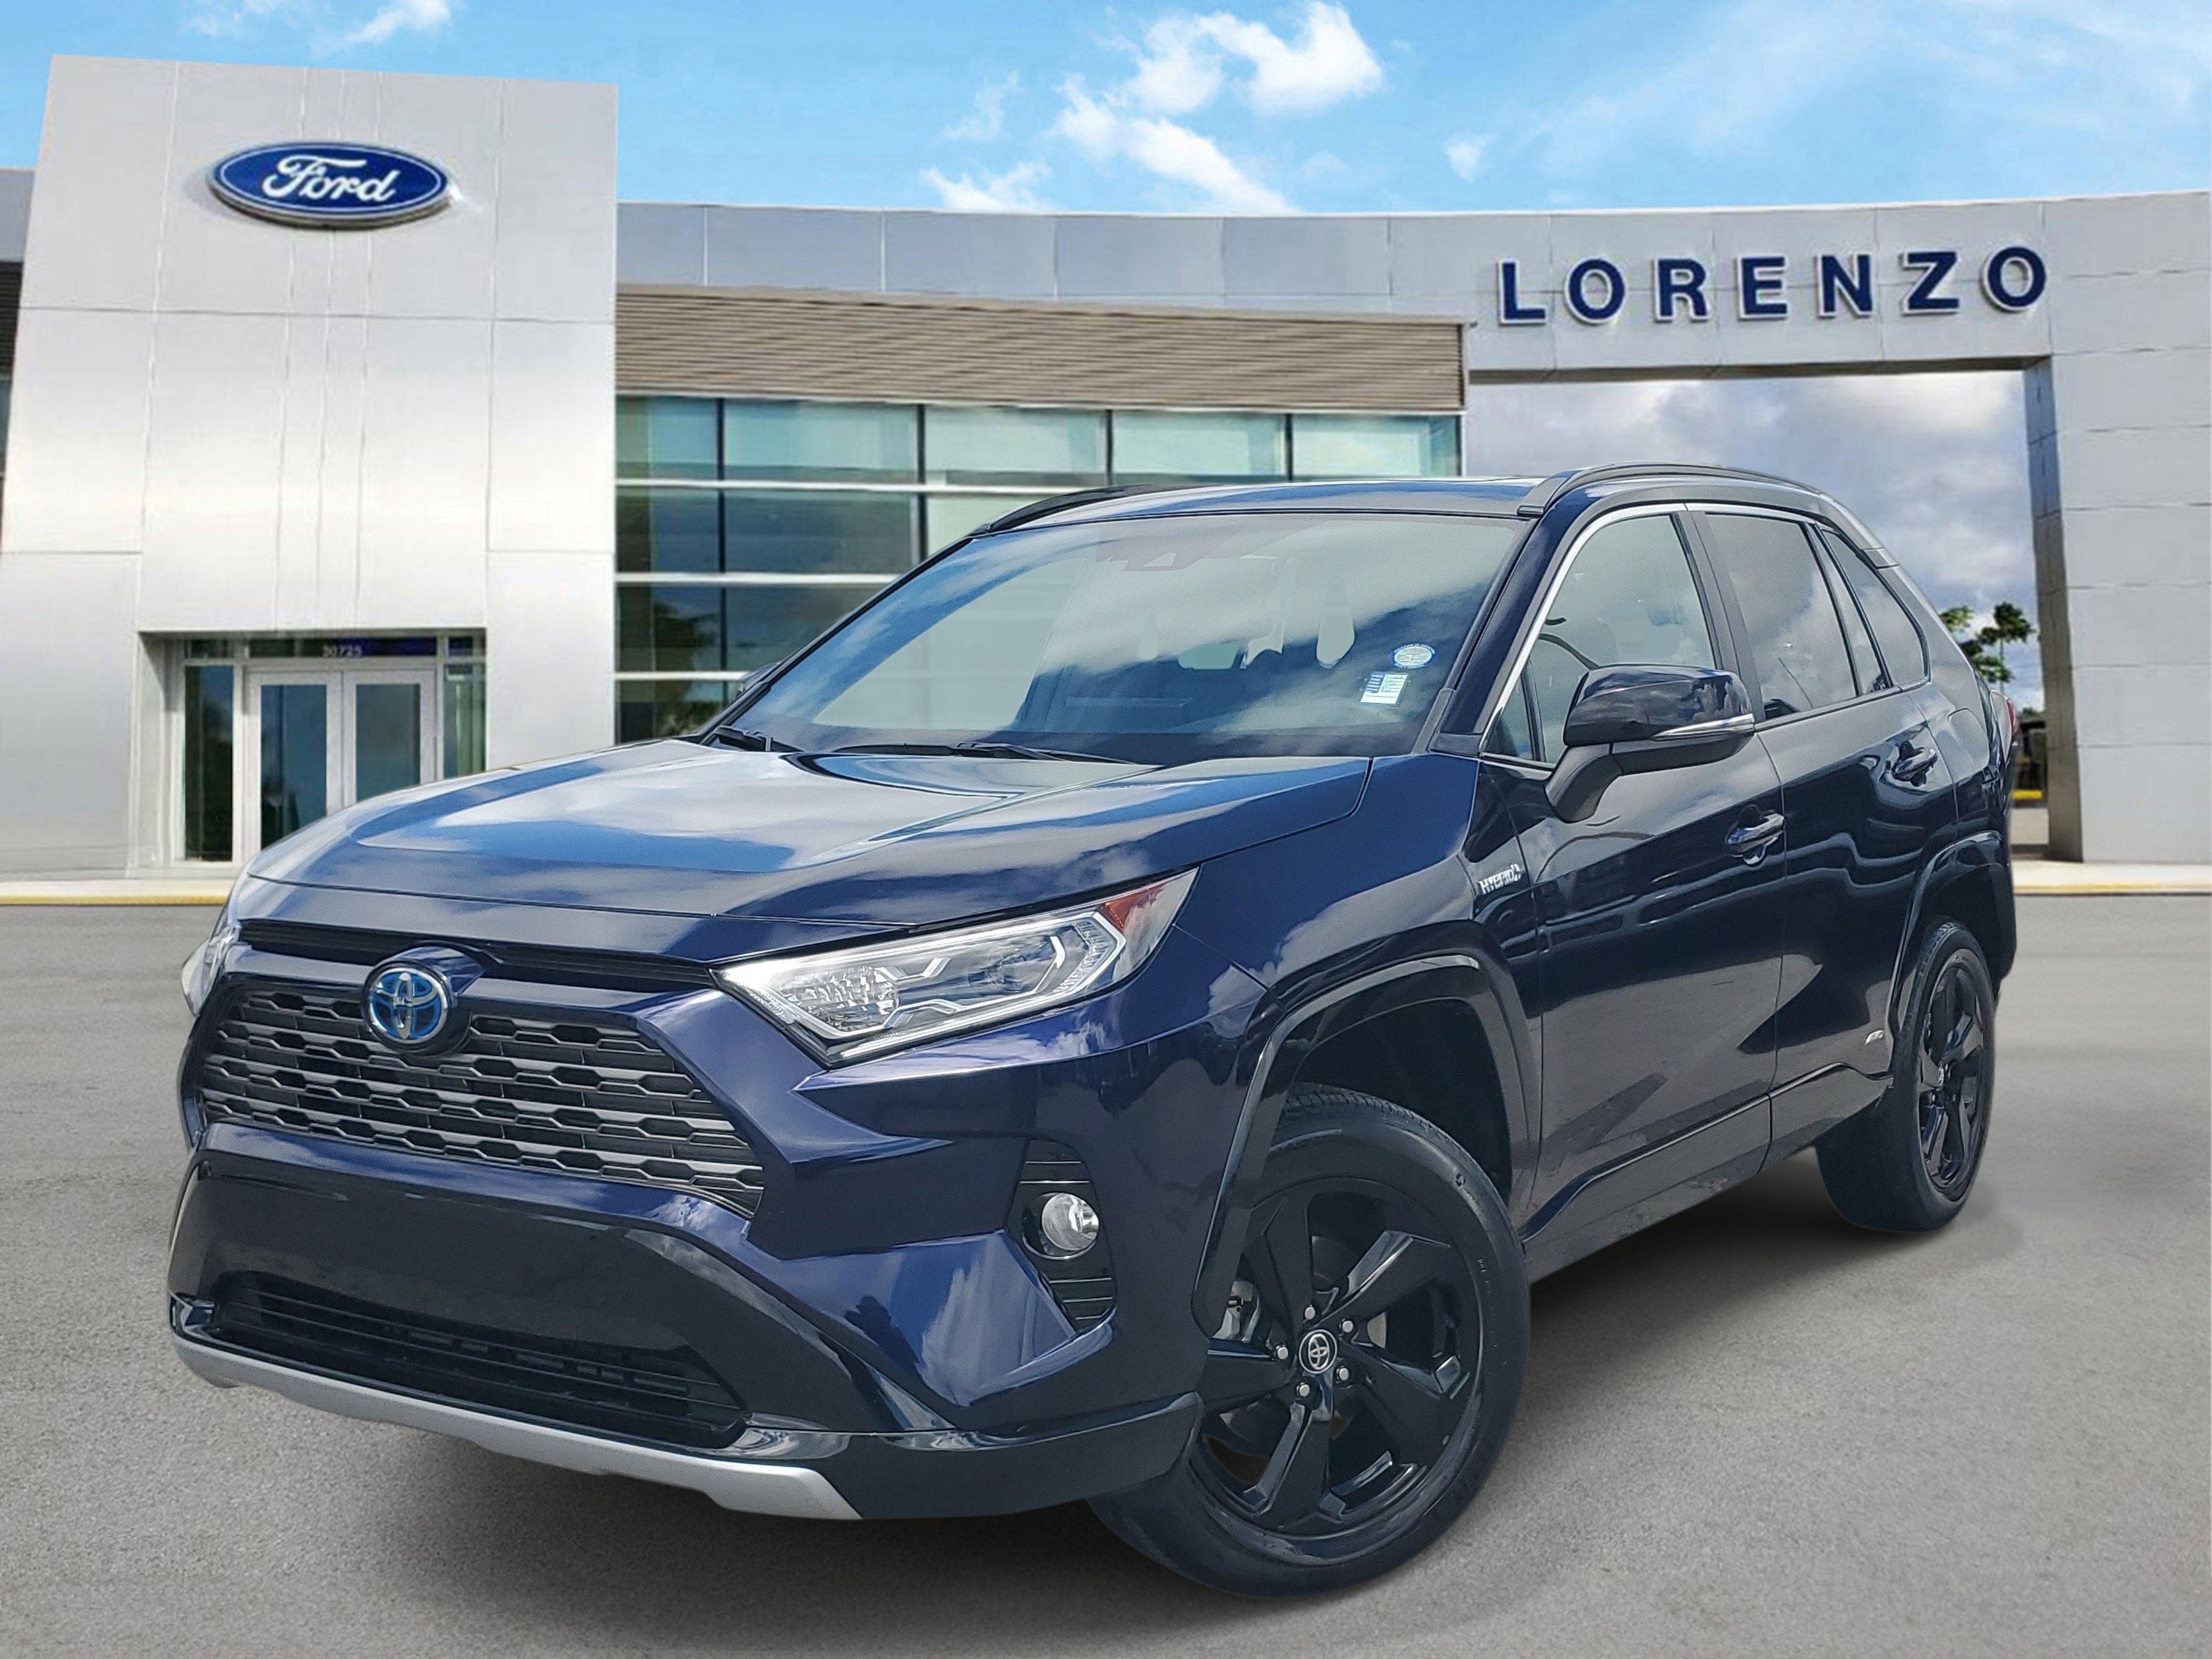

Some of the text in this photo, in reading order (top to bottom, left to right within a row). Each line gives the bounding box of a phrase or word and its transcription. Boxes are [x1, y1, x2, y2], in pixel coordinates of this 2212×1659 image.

[262, 154, 400, 201] Ford
[1498, 246, 2046, 325] LORENZO
[1479, 868, 1516, 895] HYBRID
